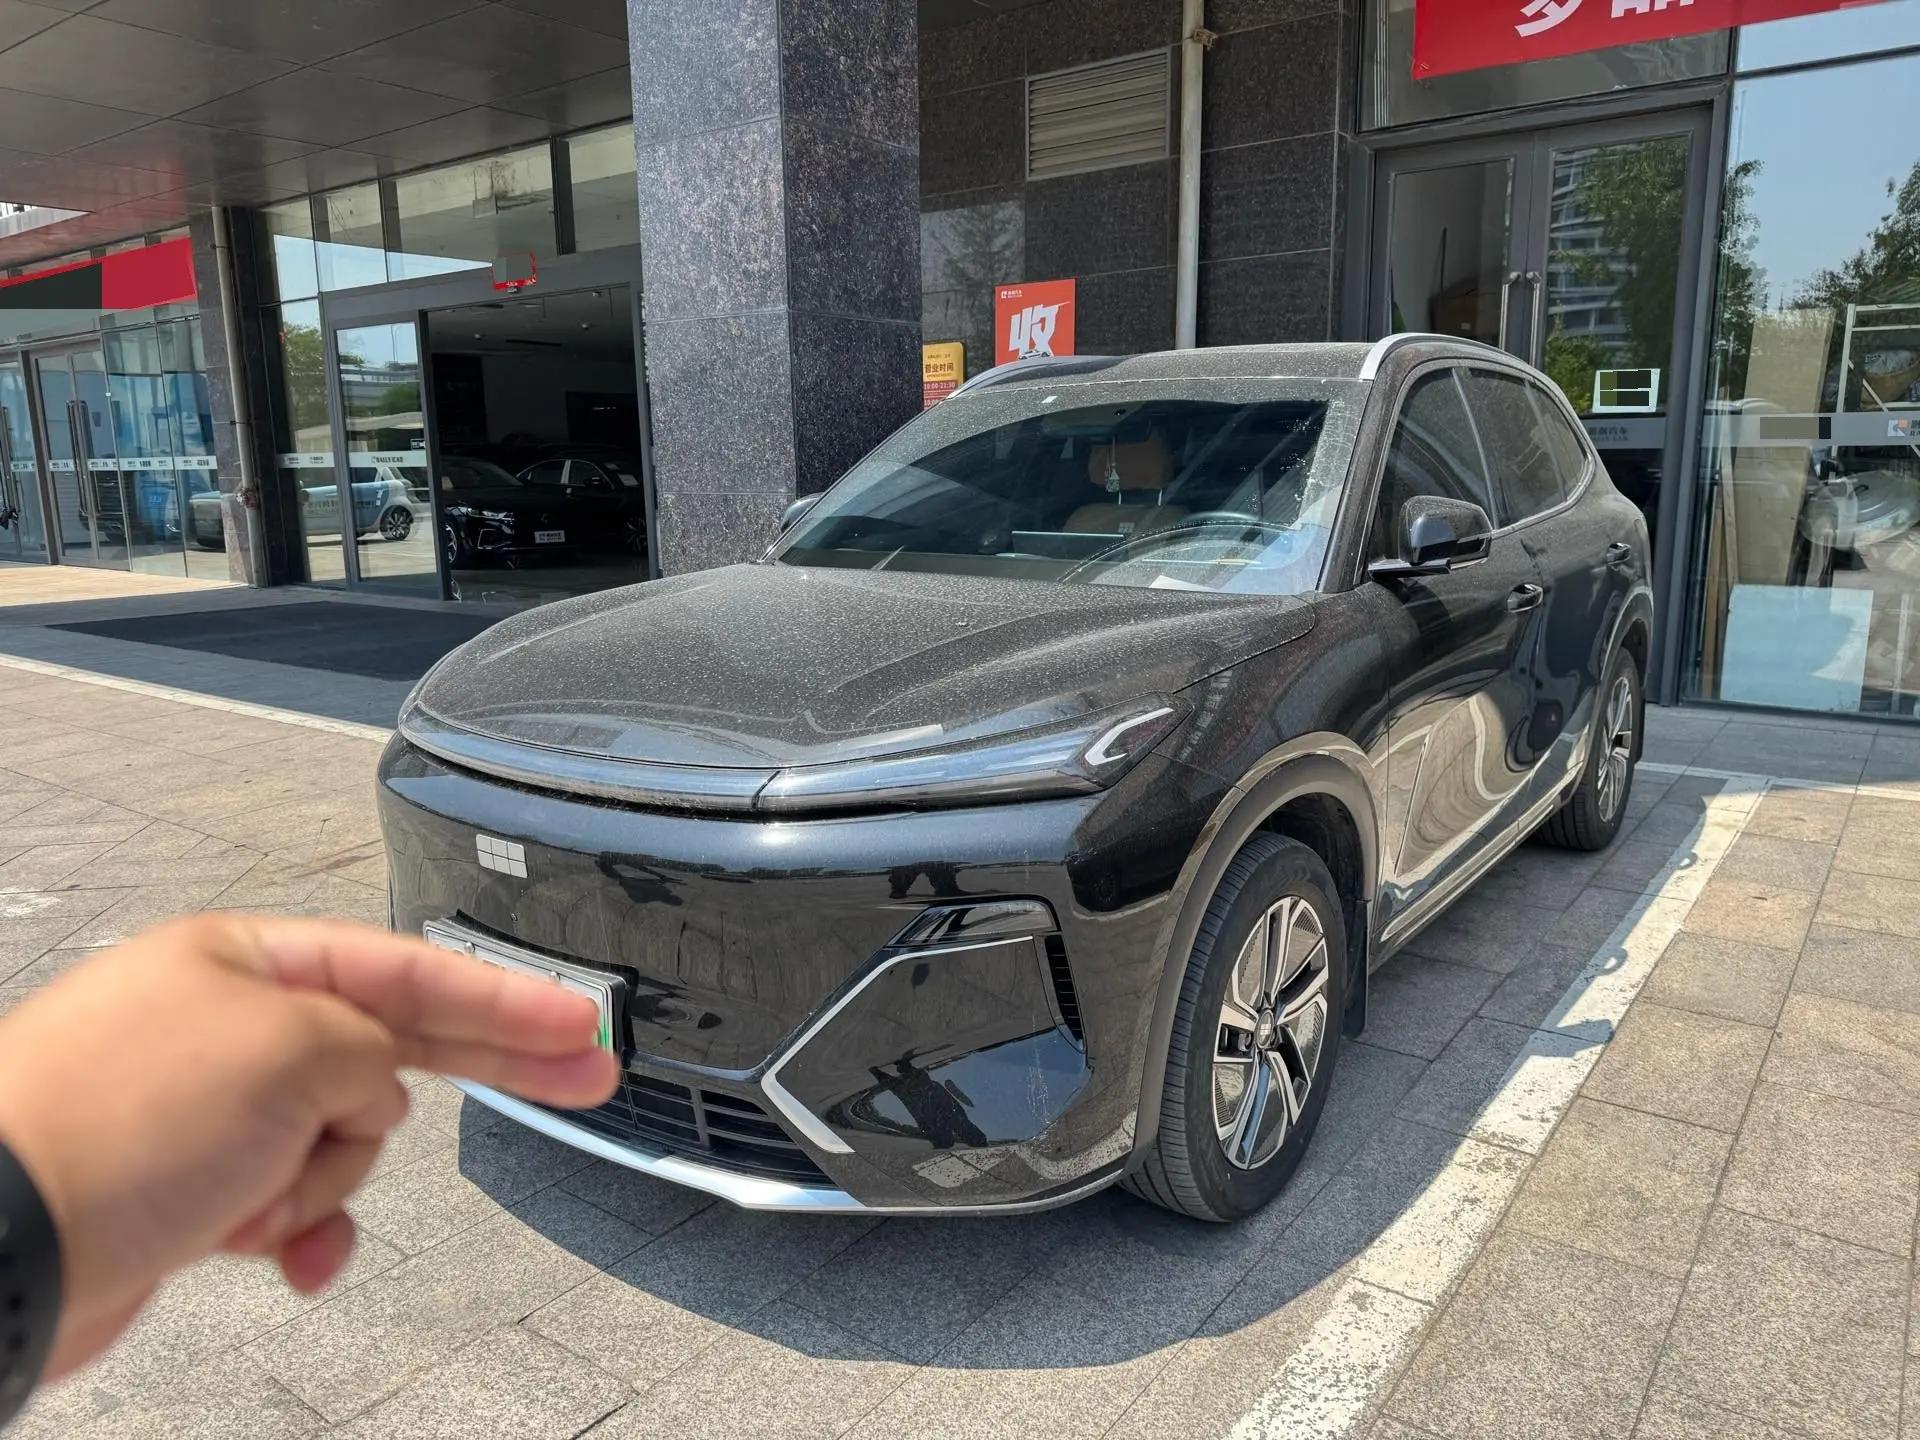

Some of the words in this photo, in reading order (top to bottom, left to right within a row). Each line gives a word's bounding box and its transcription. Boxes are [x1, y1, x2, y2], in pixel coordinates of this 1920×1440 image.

[1009, 301, 1069, 357] 收
[925, 362, 954, 373] 营业时间
